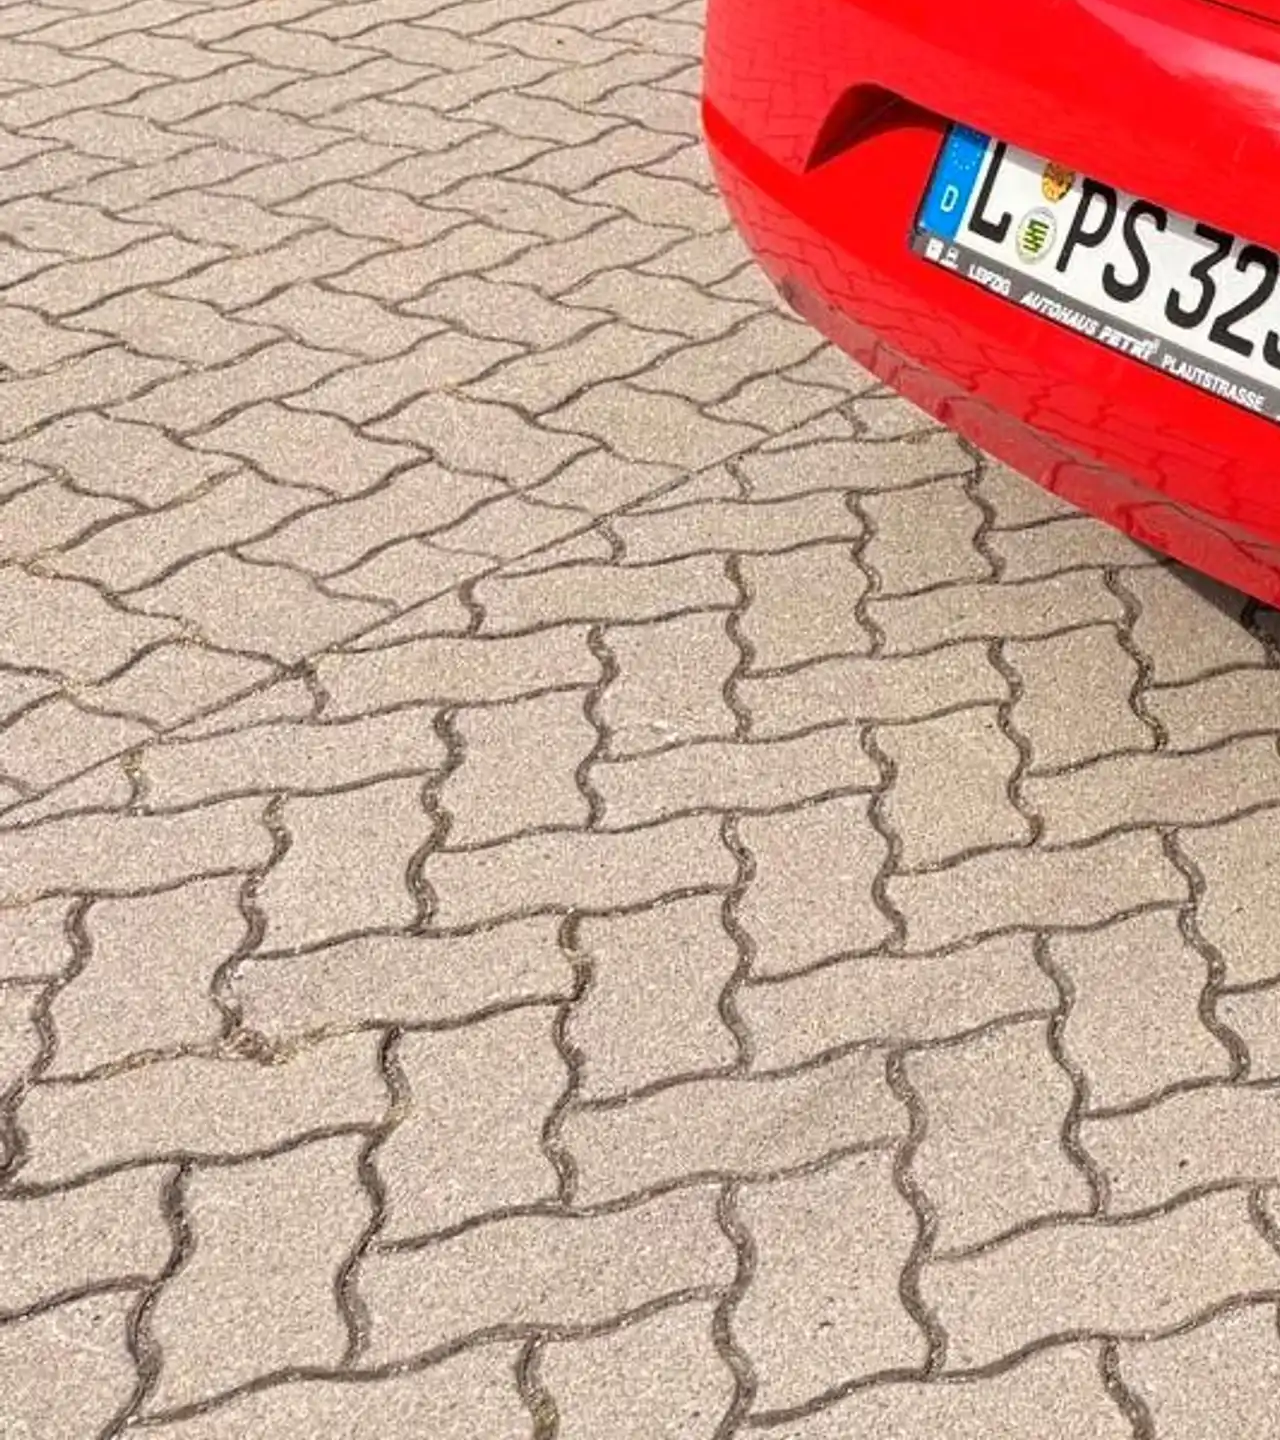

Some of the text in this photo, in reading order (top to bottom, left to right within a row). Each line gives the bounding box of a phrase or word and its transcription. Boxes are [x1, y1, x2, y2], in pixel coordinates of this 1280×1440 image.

[940, 185, 957, 213] D
[967, 142, 1012, 244] L
[1055, 176, 1168, 304] PS
[1021, 291, 1099, 337] AUTOHAUS
[1099, 325, 1158, 361] PETRI
[1161, 354, 1267, 412] PLAUTSTRASSE
